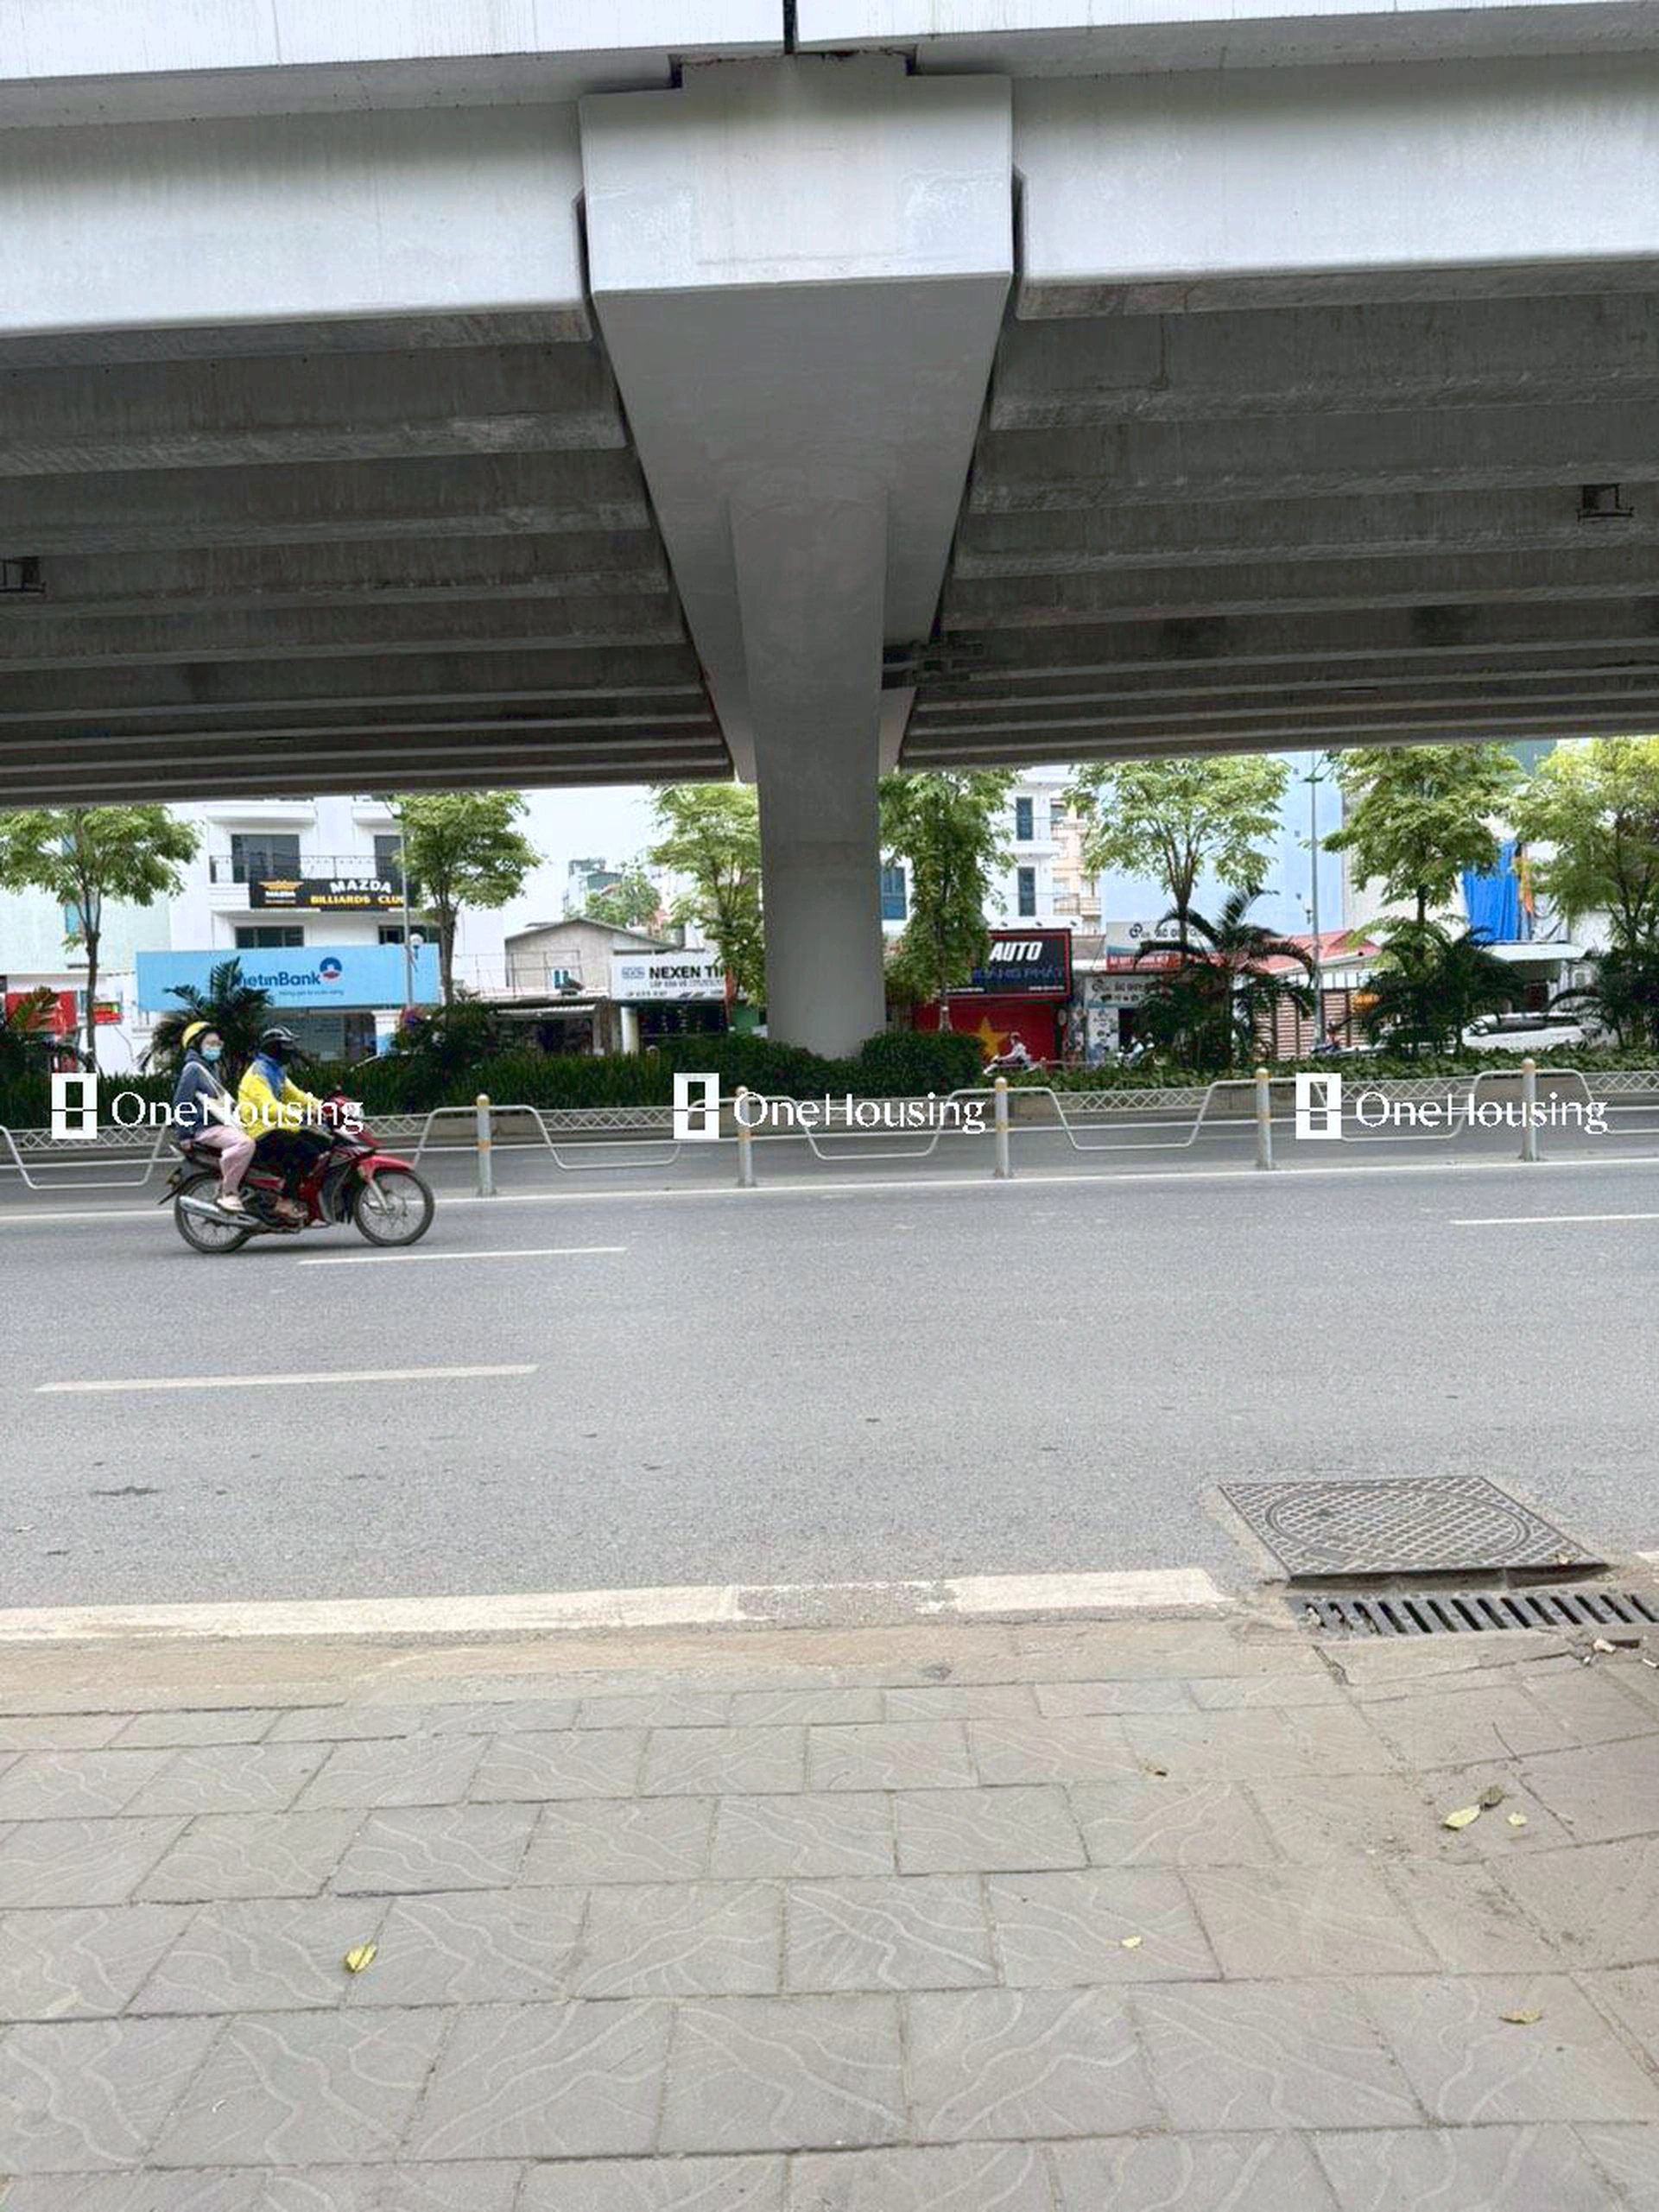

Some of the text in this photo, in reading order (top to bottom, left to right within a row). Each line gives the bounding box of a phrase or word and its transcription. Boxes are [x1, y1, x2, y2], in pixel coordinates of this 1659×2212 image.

[330, 879, 392, 893] MAZDA
[310, 895, 371, 905] BILLIARDS
[989, 941, 1043, 961] AUTO
[237, 971, 321, 987] ietinBank
[649, 966, 700, 979] NEXEN
